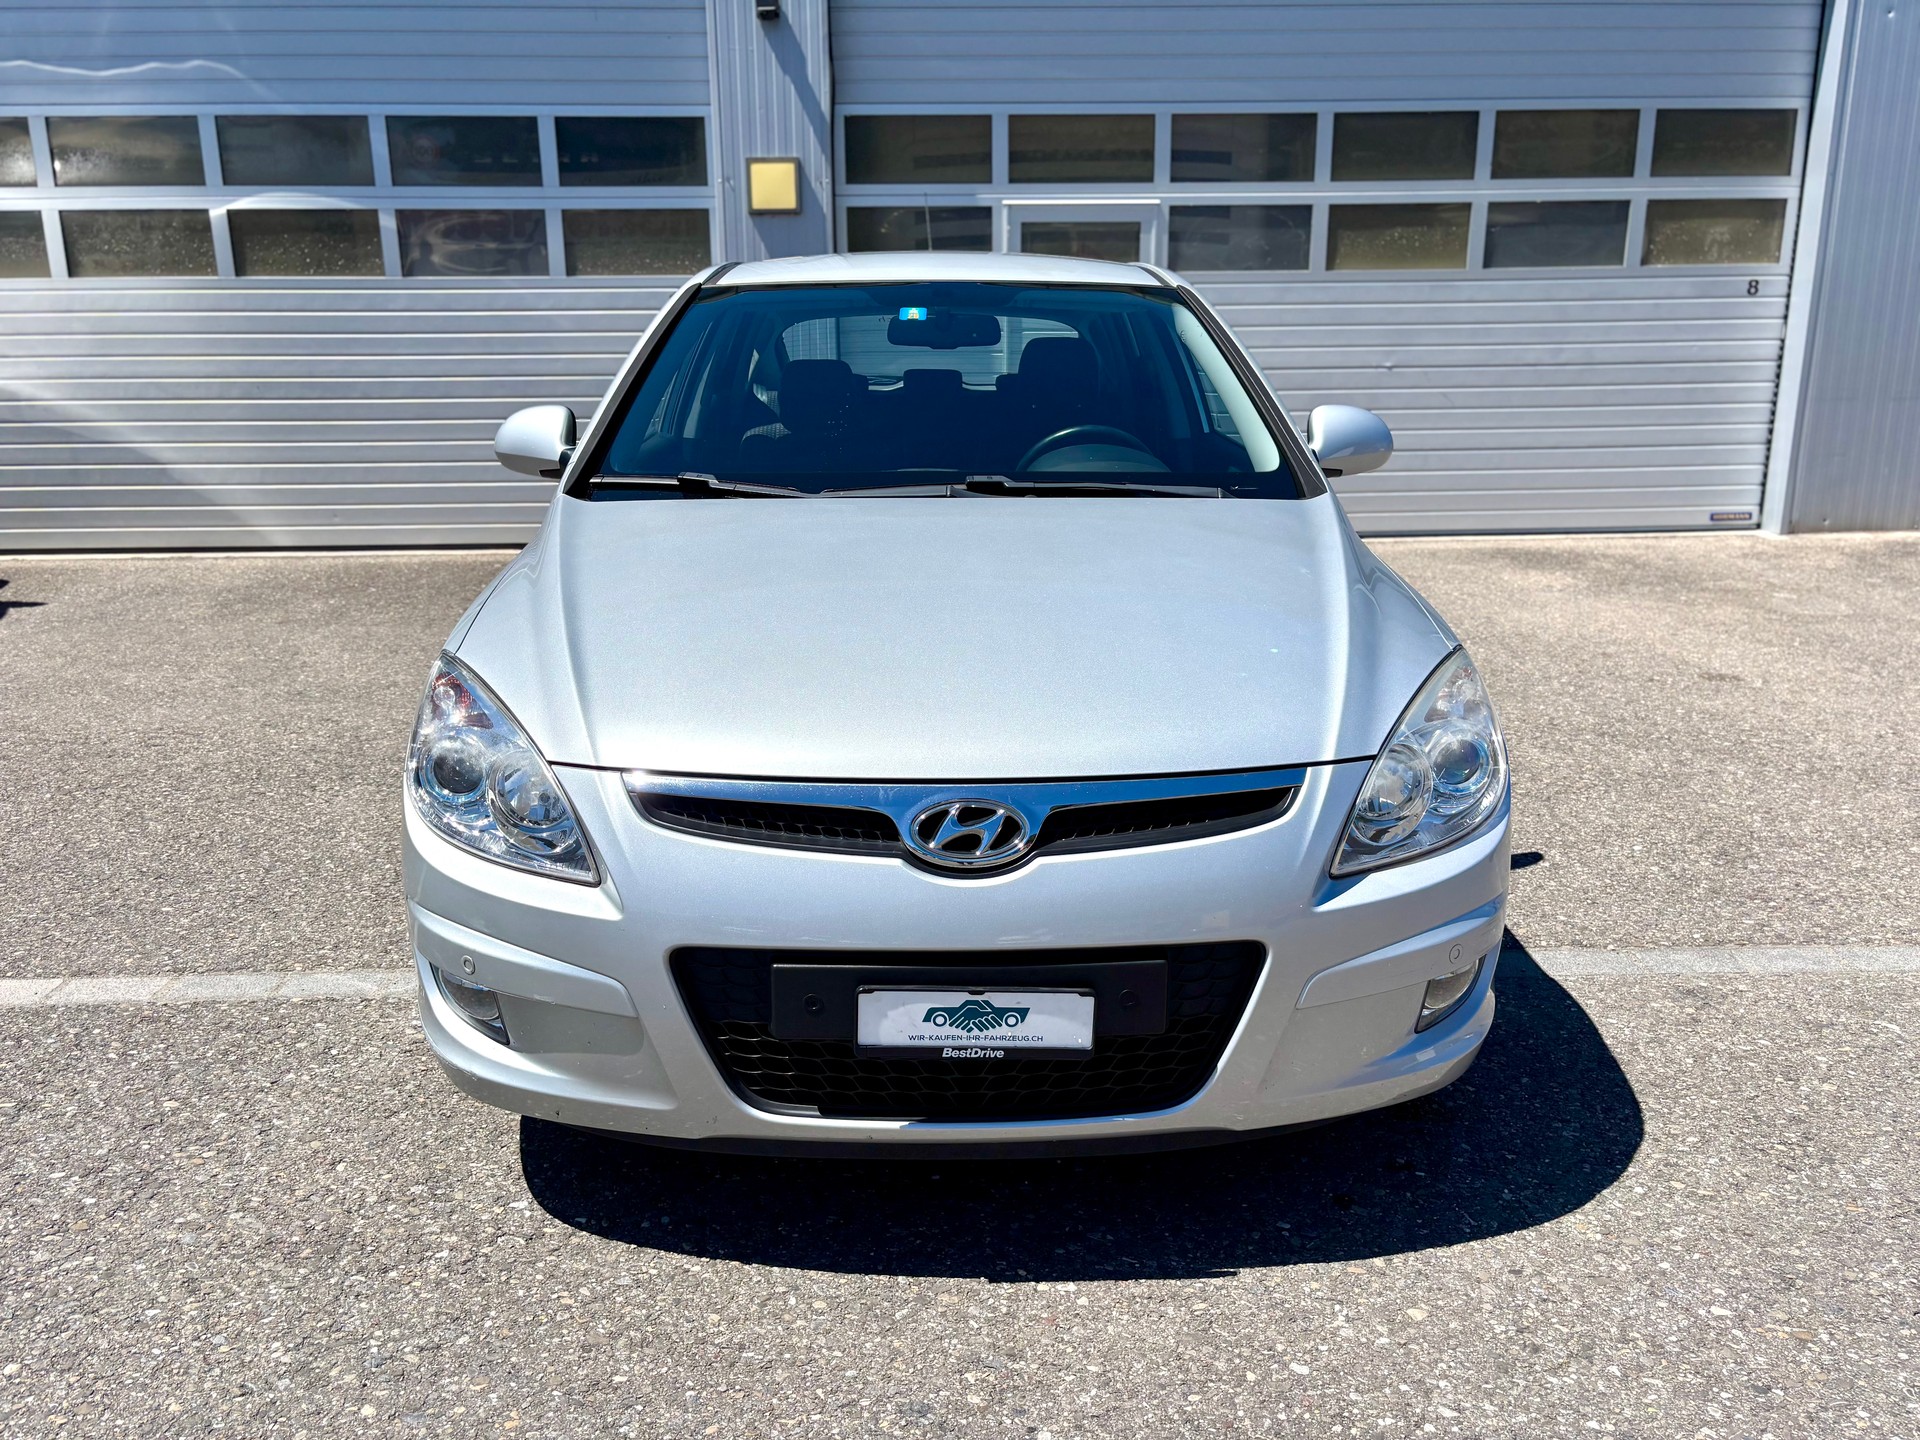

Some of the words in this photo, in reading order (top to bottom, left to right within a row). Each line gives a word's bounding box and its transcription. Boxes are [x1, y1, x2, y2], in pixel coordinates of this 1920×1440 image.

[1747, 279, 1759, 296] 8
[908, 1034, 1043, 1042] WIR-KAUFEN-IHR-FAHRZEUG.CH
[942, 1047, 1005, 1058] BestDrive
